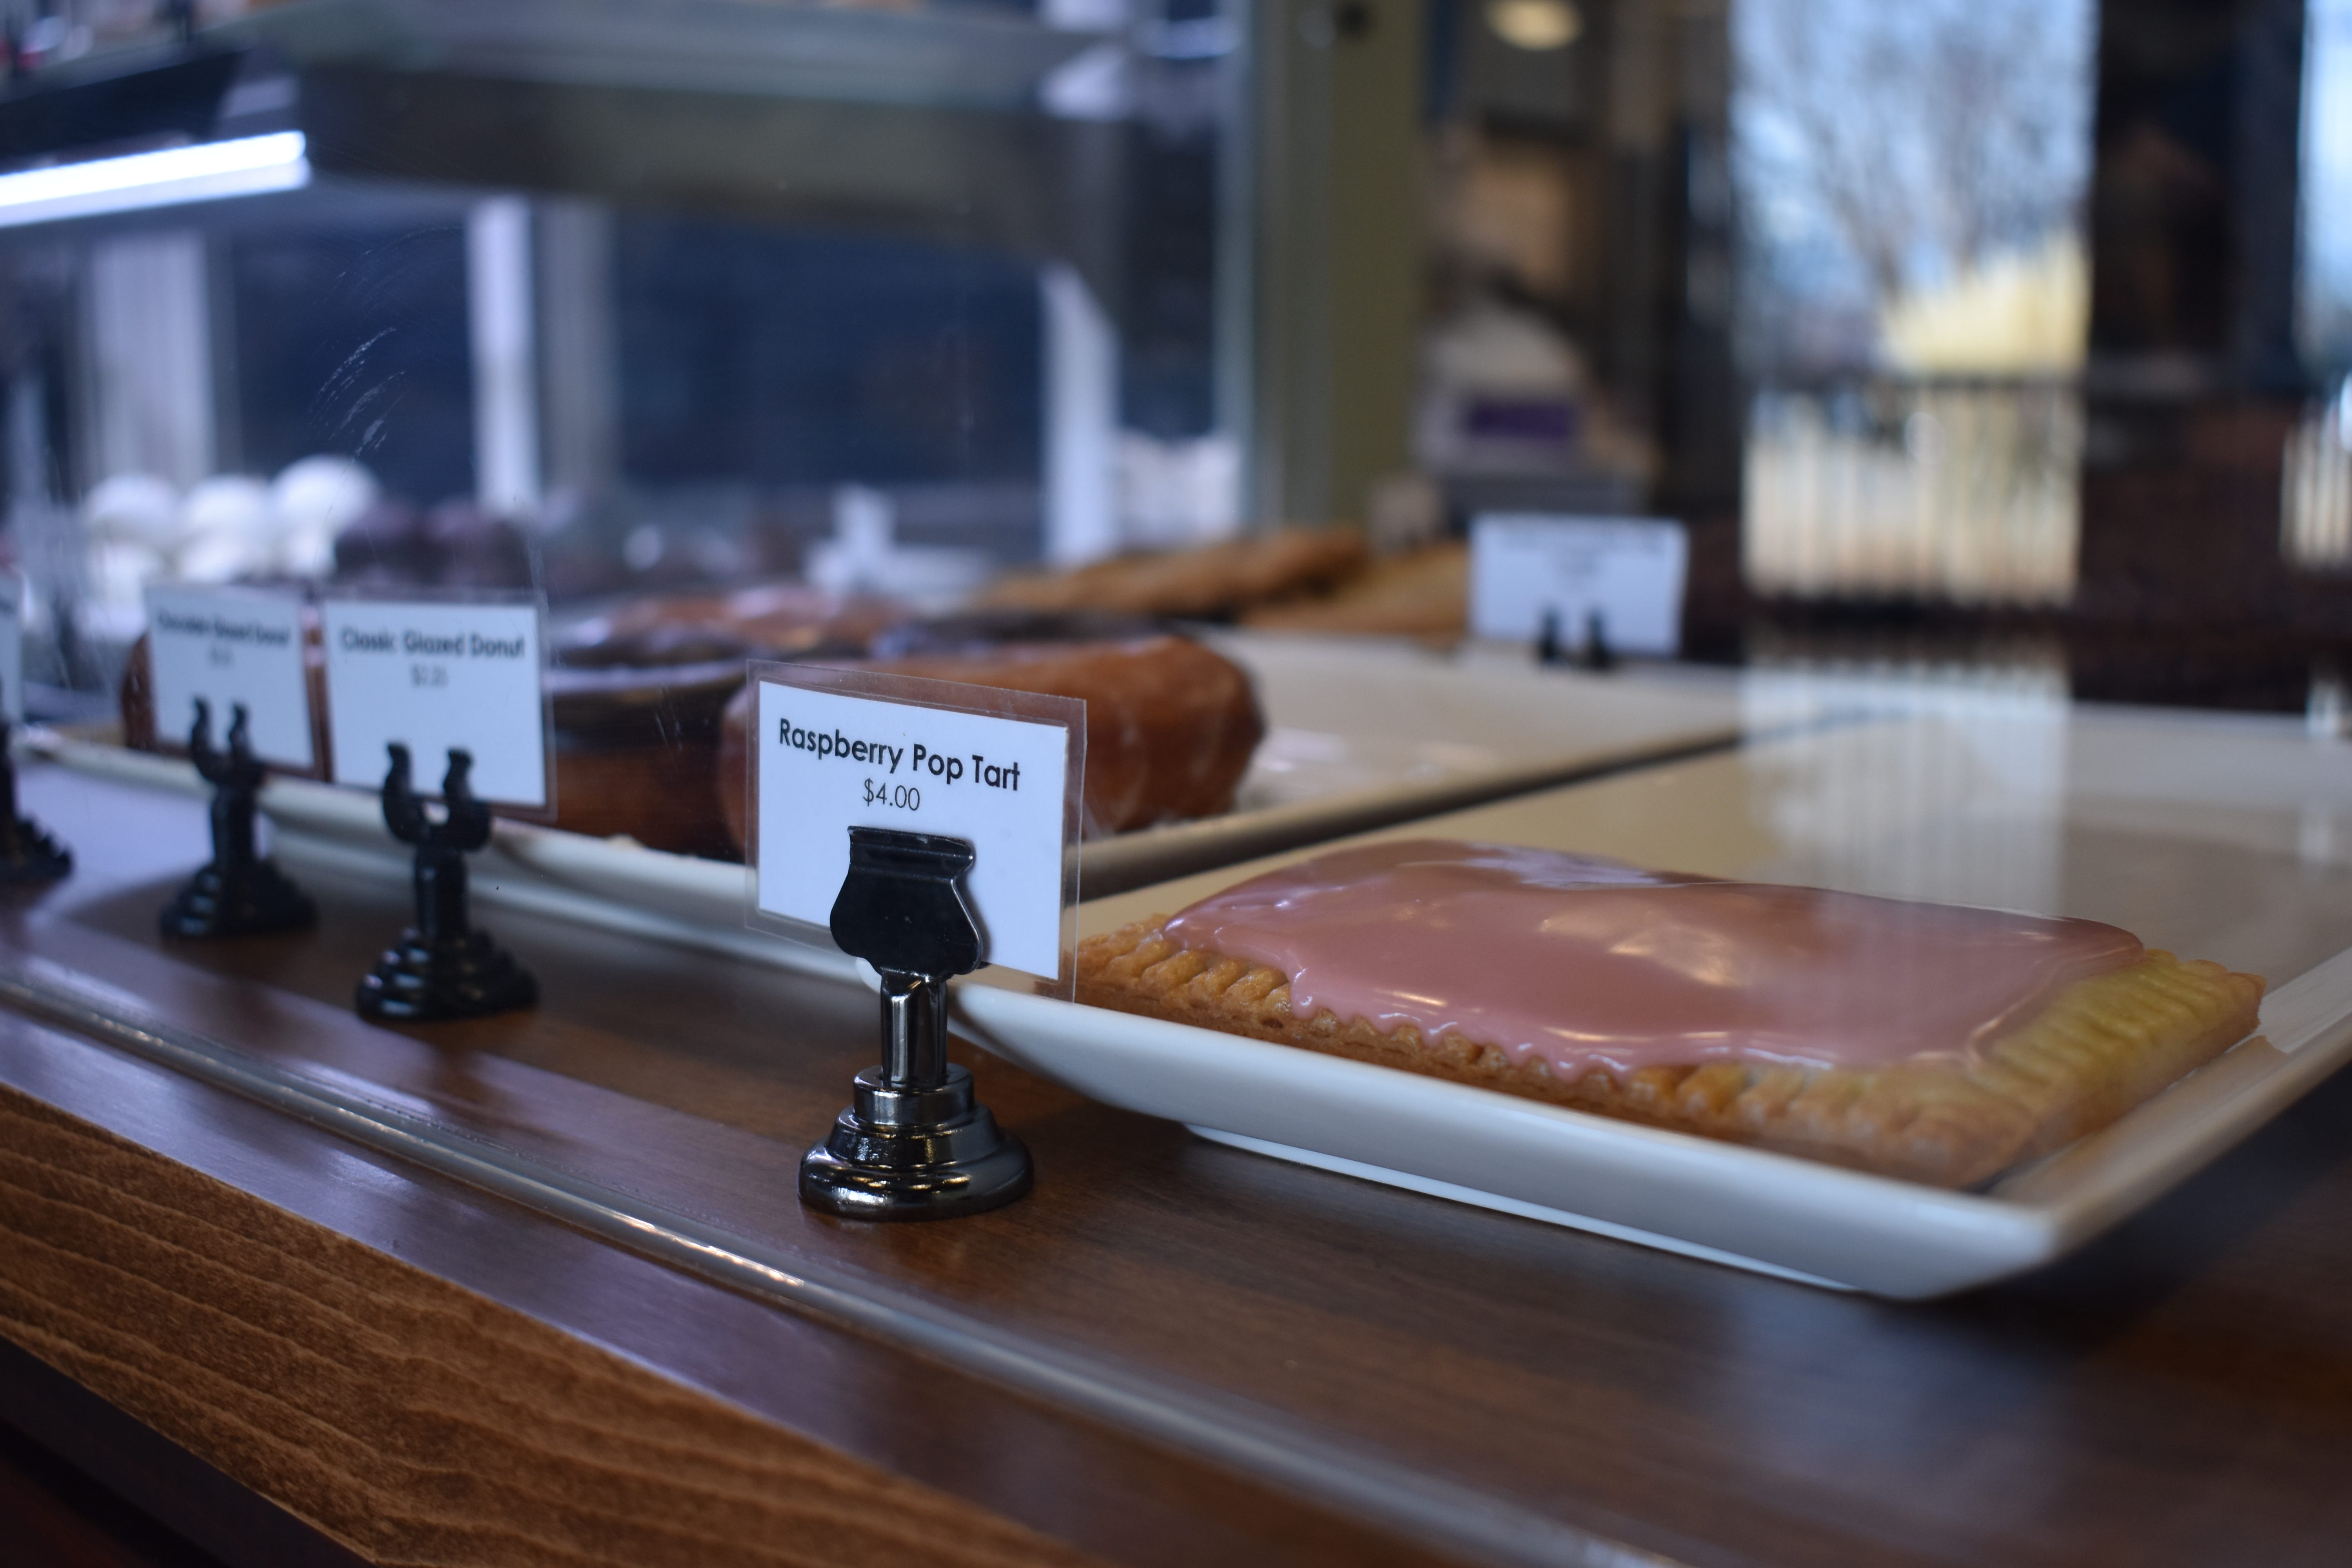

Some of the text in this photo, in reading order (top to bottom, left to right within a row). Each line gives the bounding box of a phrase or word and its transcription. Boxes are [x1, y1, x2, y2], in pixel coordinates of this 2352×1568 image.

[341, 627, 524, 659] Classic Glazed Donut
[780, 718, 1020, 791] Raspberry Pop Tart
[863, 778, 920, 811] $4.00
